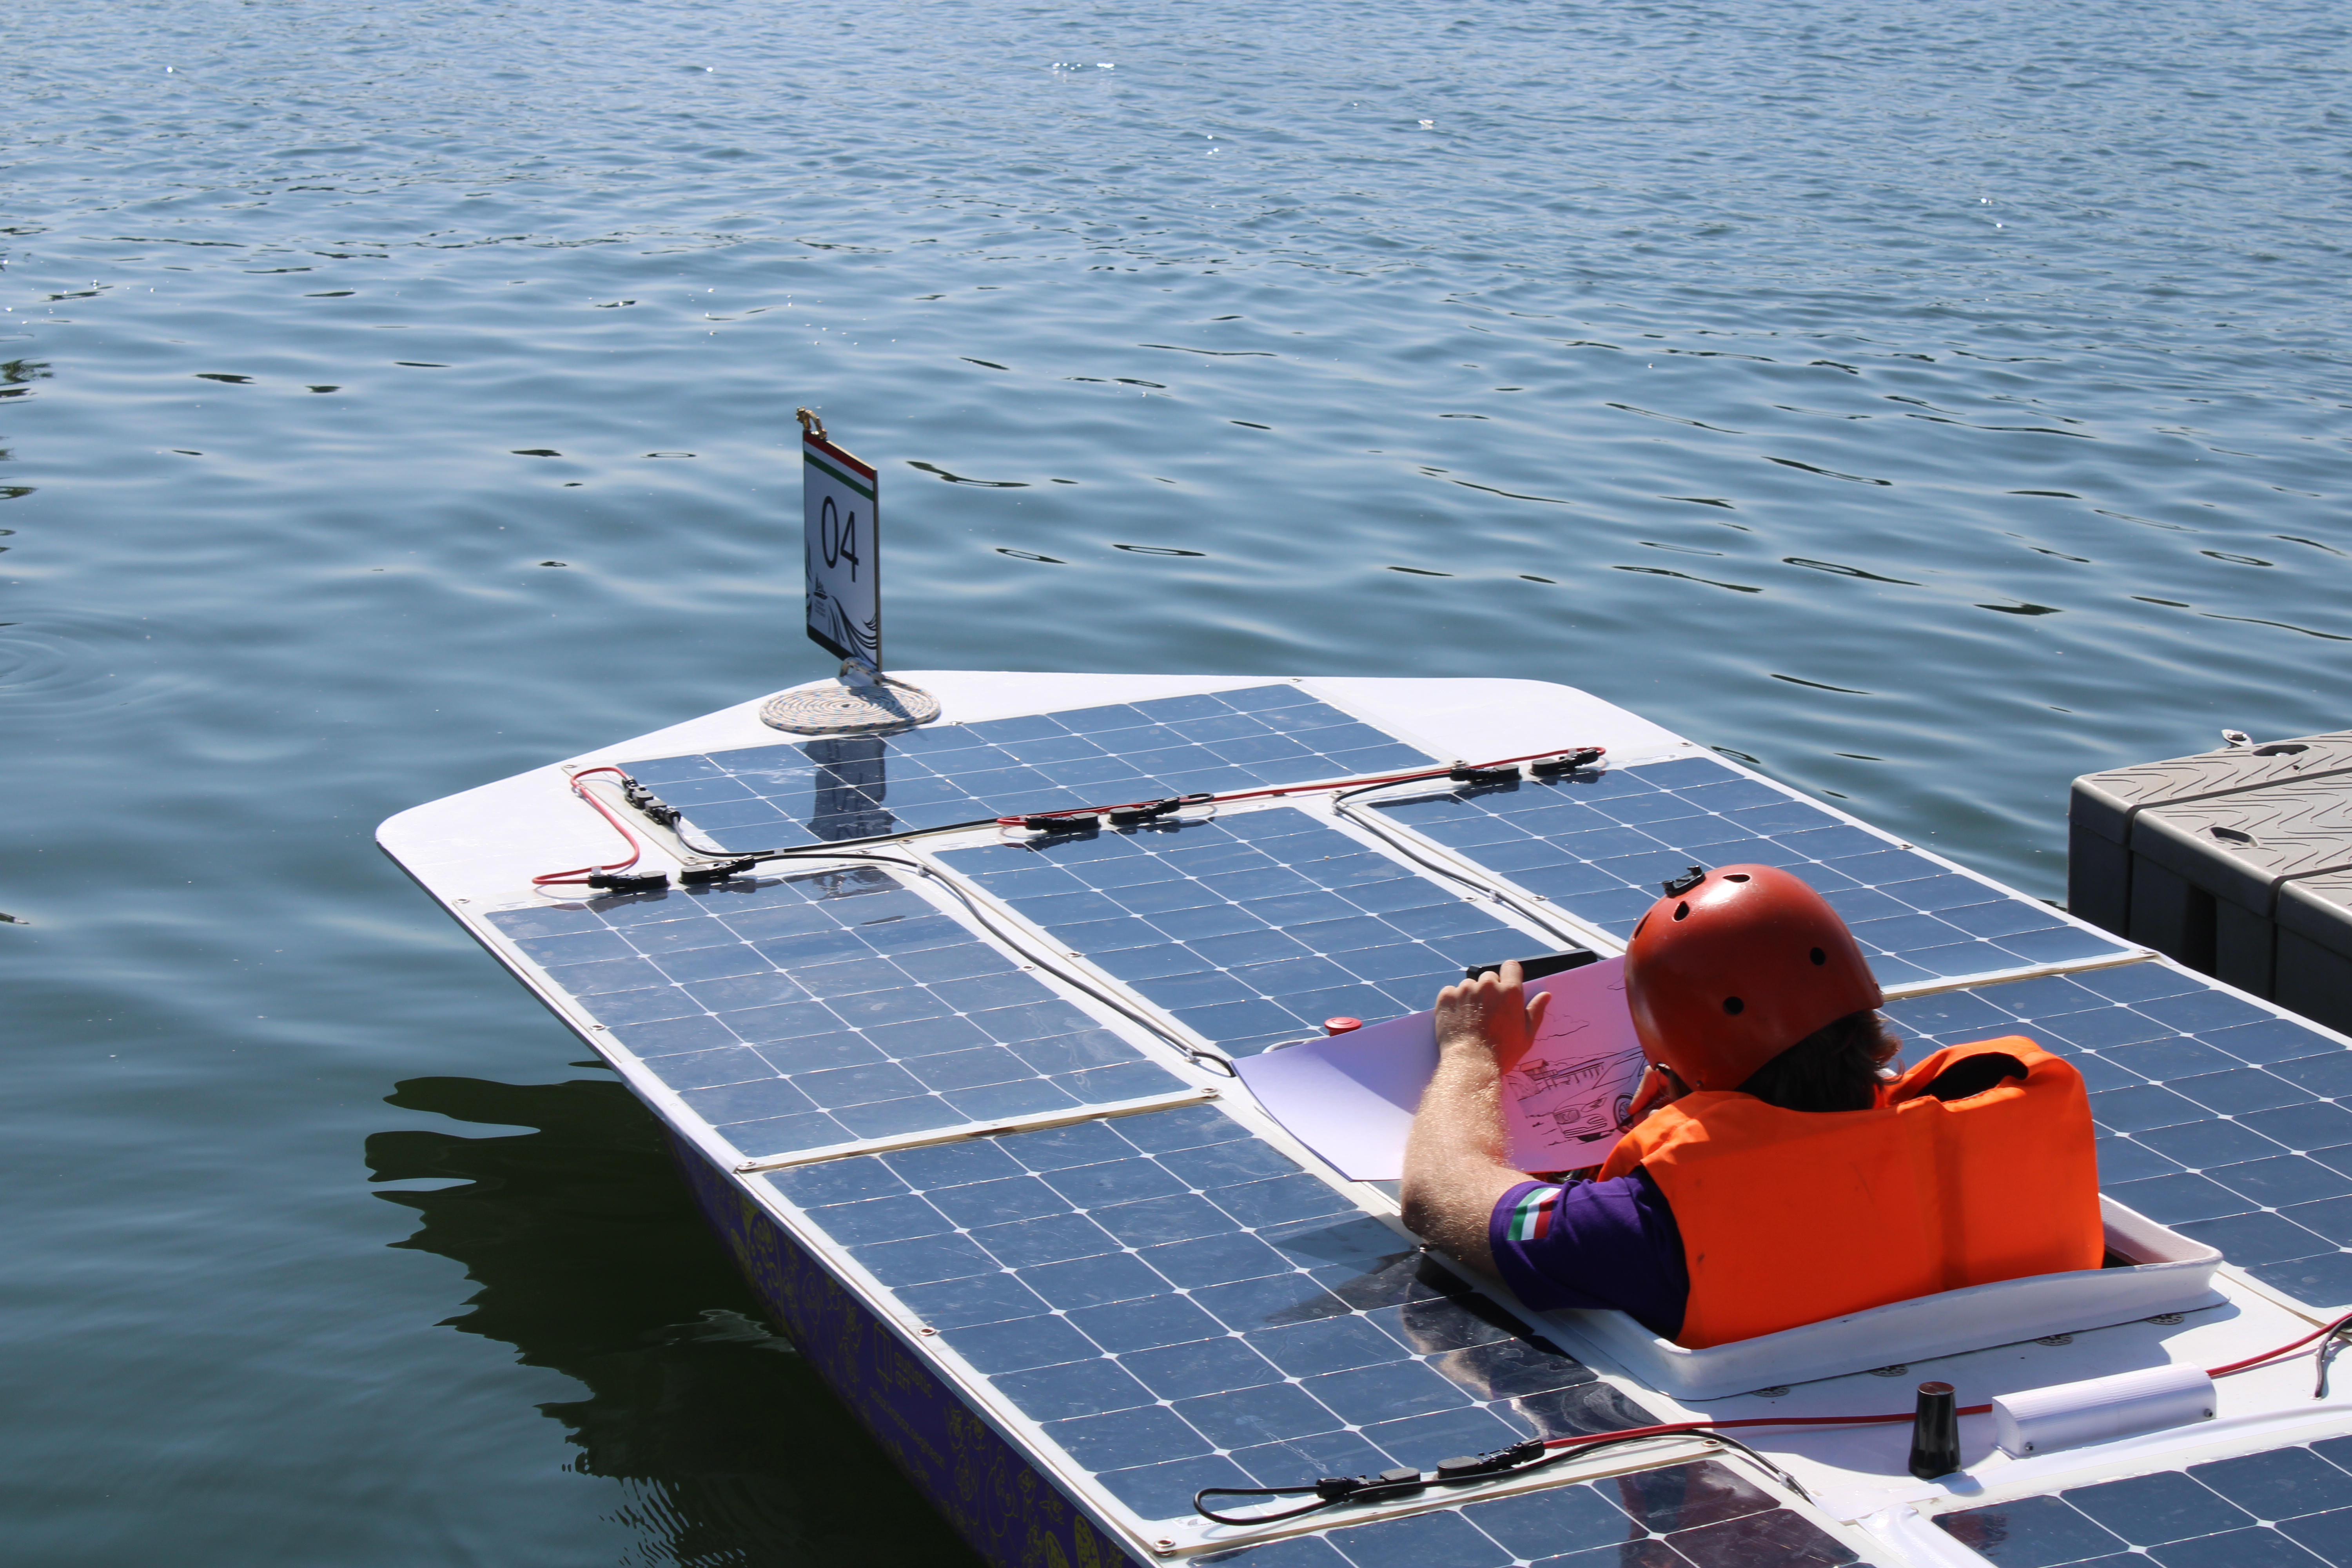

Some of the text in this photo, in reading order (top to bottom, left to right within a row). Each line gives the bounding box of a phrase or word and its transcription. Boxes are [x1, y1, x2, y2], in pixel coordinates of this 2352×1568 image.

[821, 495, 859, 583] 04
[895, 1352, 932, 1398] autistic
[895, 1370, 911, 1396] art
